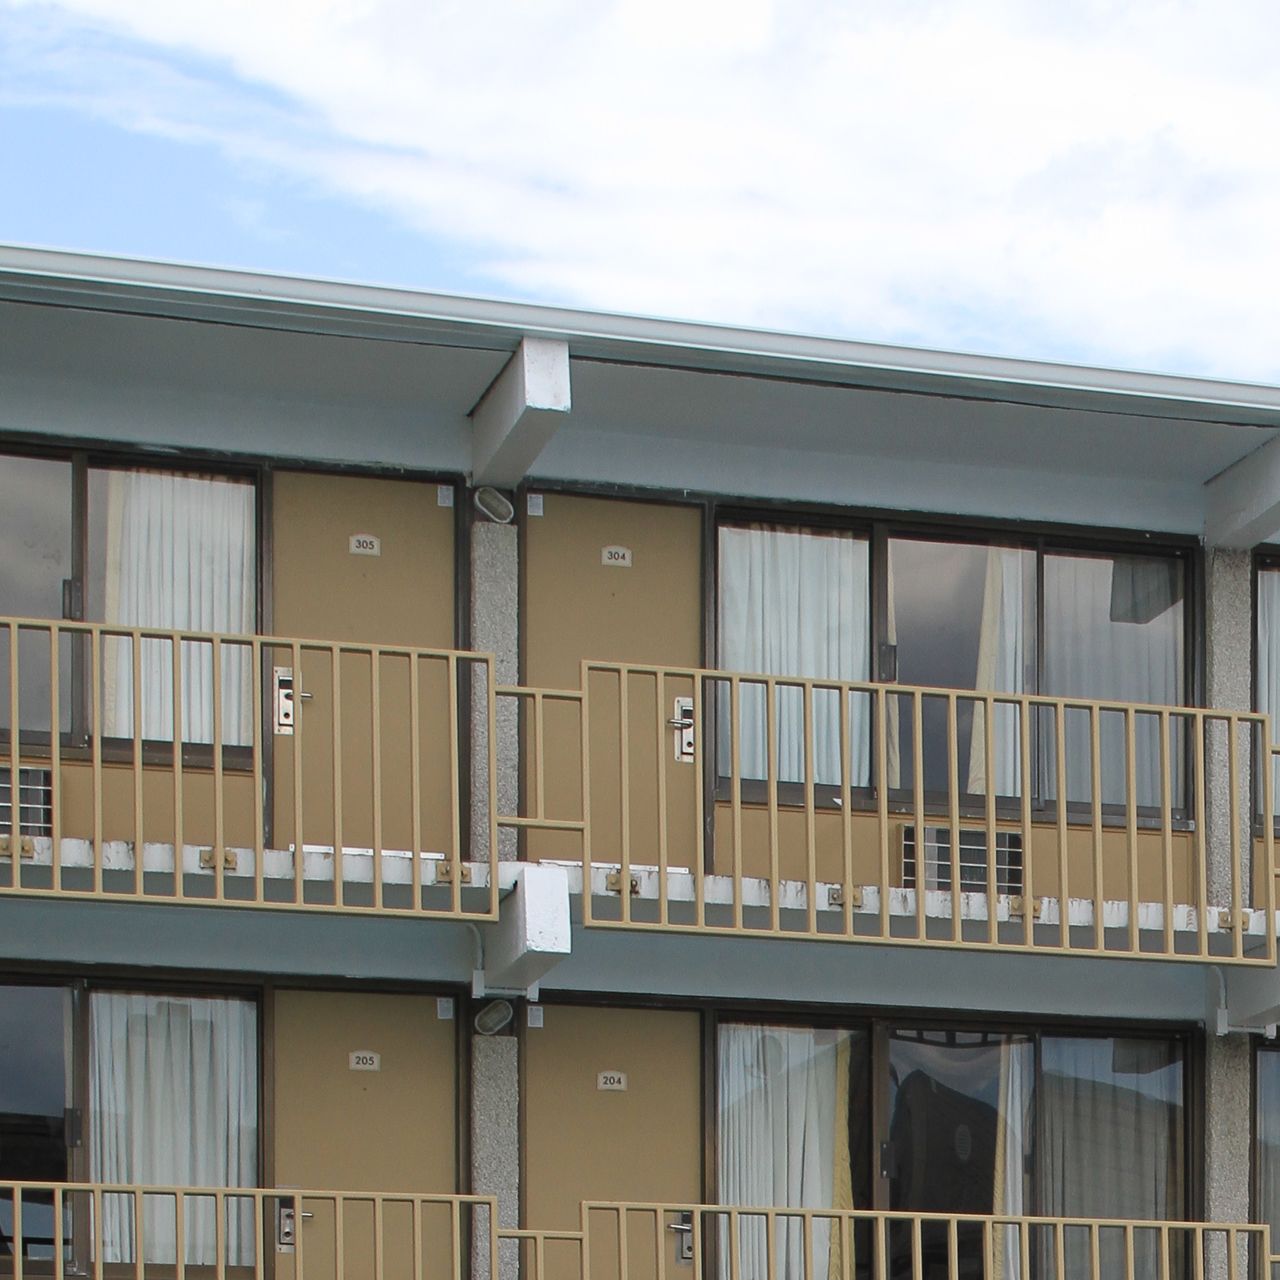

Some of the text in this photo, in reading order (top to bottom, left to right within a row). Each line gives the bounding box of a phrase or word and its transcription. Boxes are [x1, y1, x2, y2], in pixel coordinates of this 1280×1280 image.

[355, 539, 375, 550] 305
[607, 550, 626, 561] 304
[355, 1055, 375, 1066] 205
[602, 1075, 622, 1086] 204
